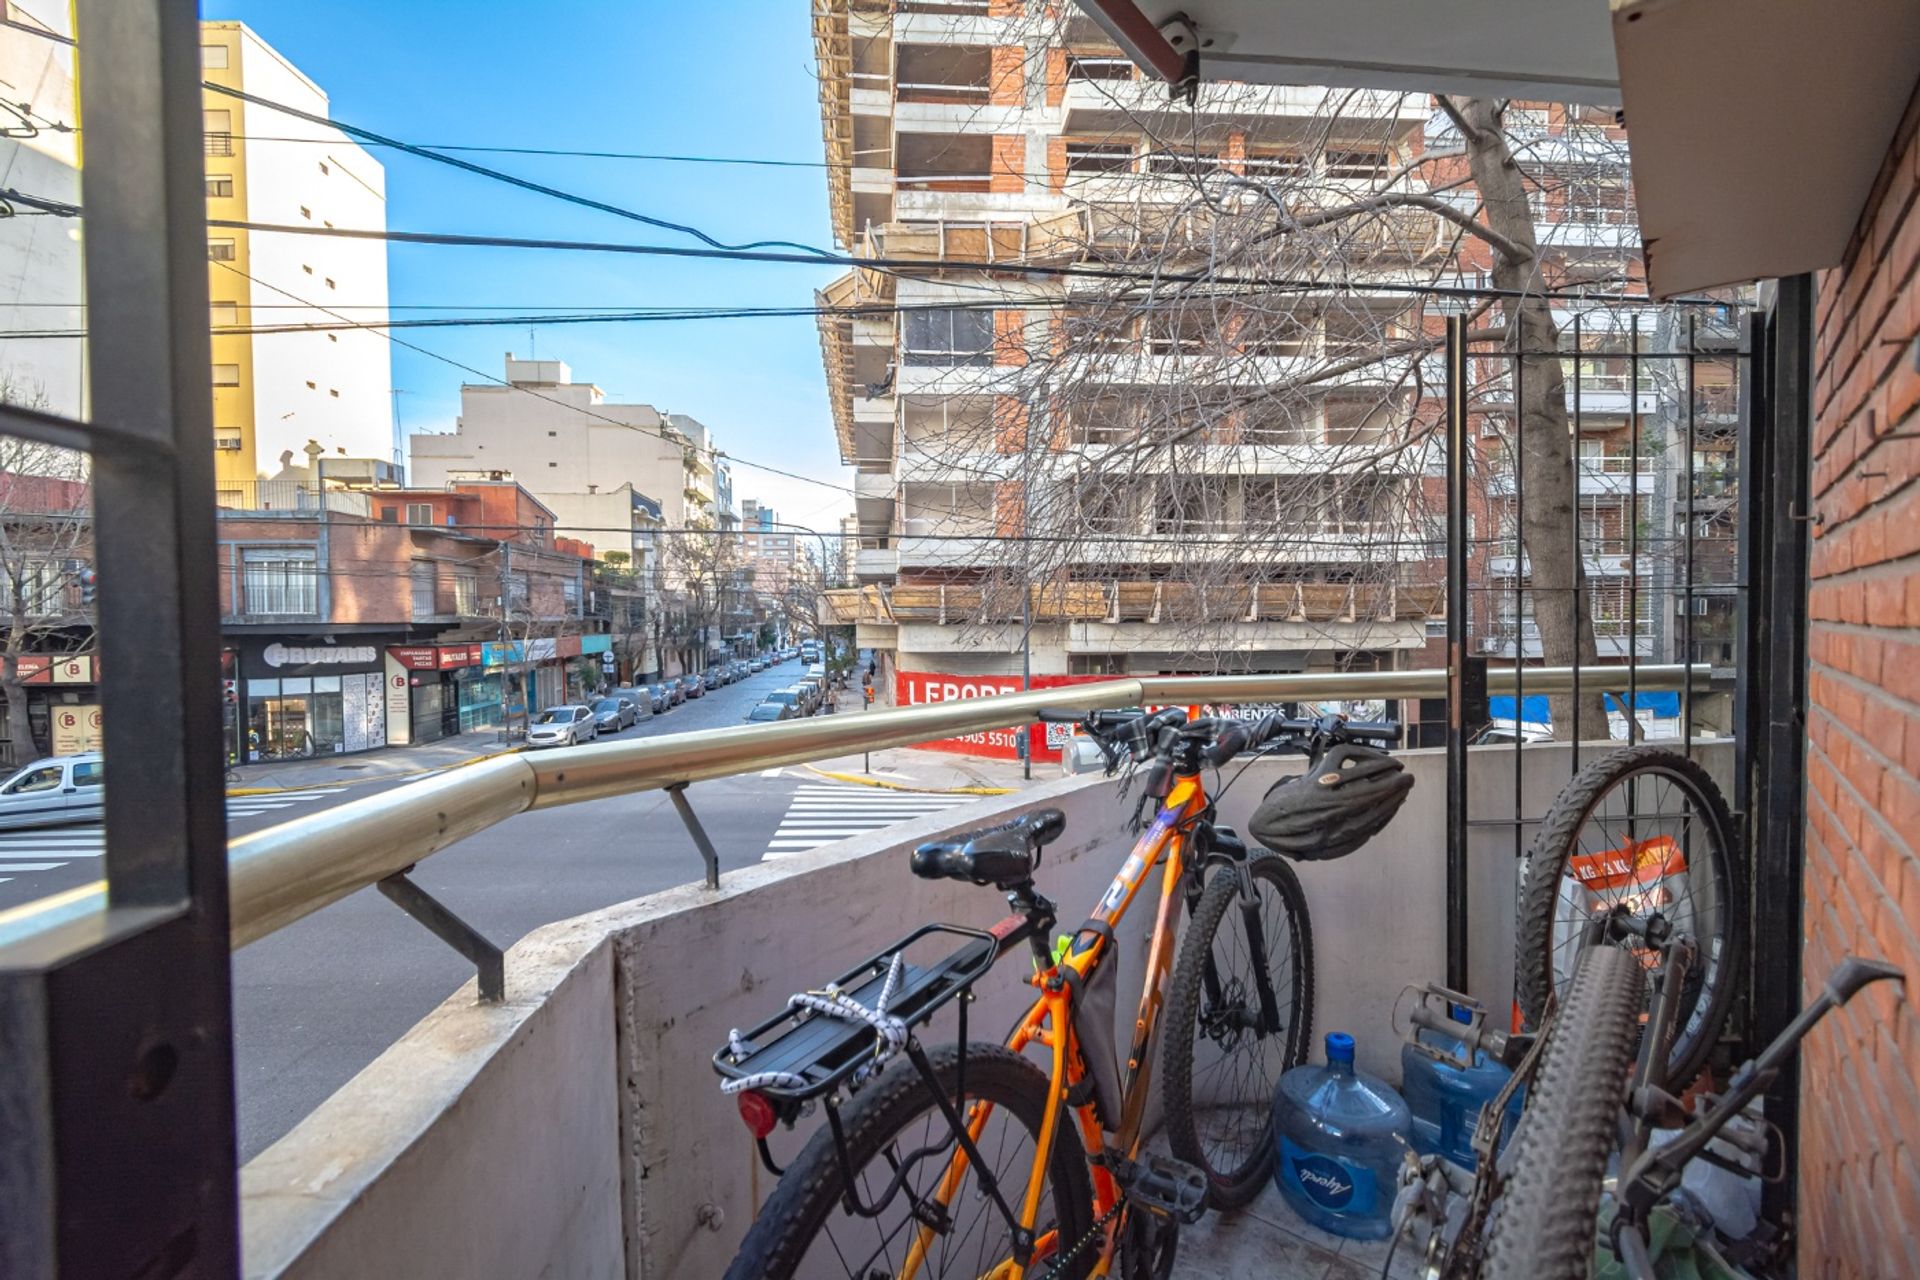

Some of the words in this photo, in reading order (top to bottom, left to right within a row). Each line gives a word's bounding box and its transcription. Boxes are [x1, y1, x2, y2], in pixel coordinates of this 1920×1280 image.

[263, 643, 376, 668] BRUTALES
[988, 732, 1016, 748] 5510
[1579, 864, 1597, 880] KG
